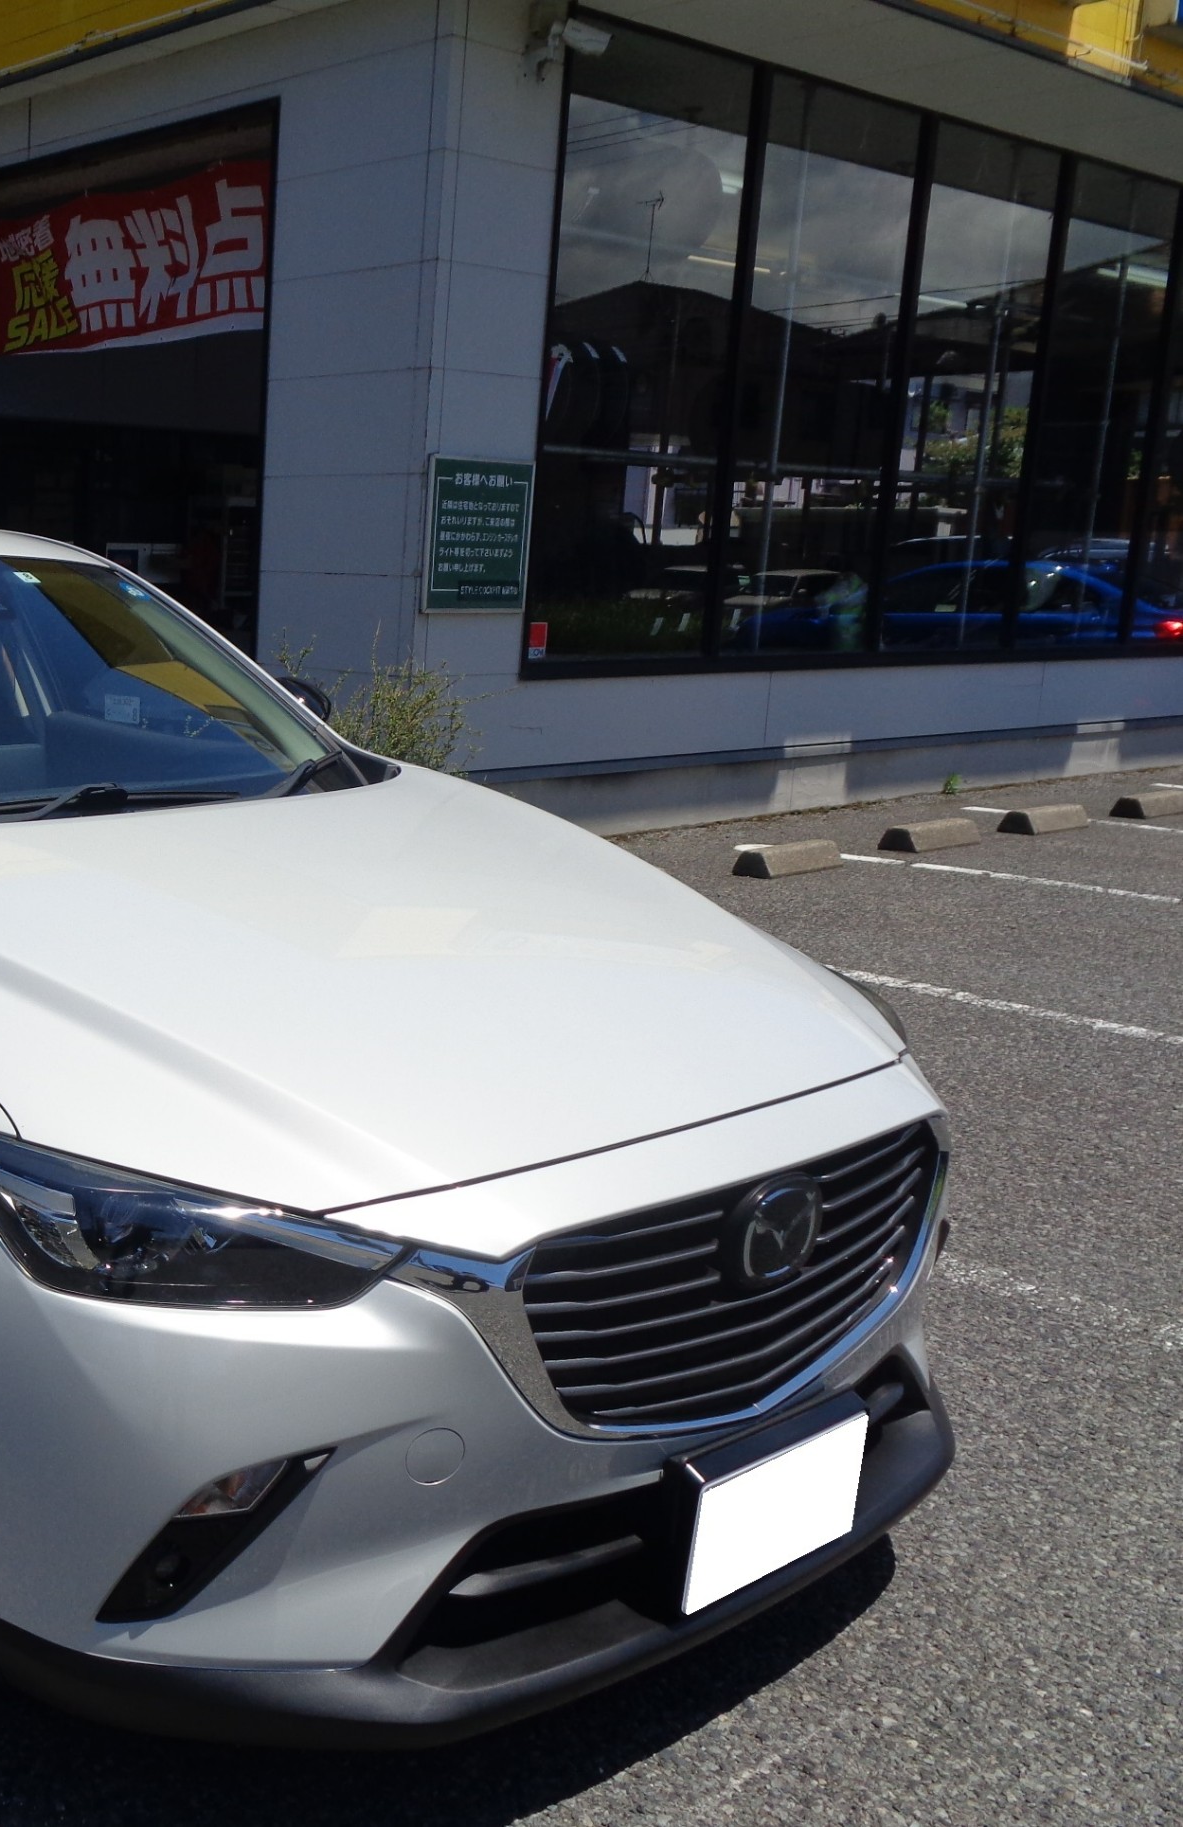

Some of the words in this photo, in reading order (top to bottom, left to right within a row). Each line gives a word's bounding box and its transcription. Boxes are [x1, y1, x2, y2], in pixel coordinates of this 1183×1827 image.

[3, 296, 79, 352] SALE
[454, 472, 513, 488] お客様へお願い
